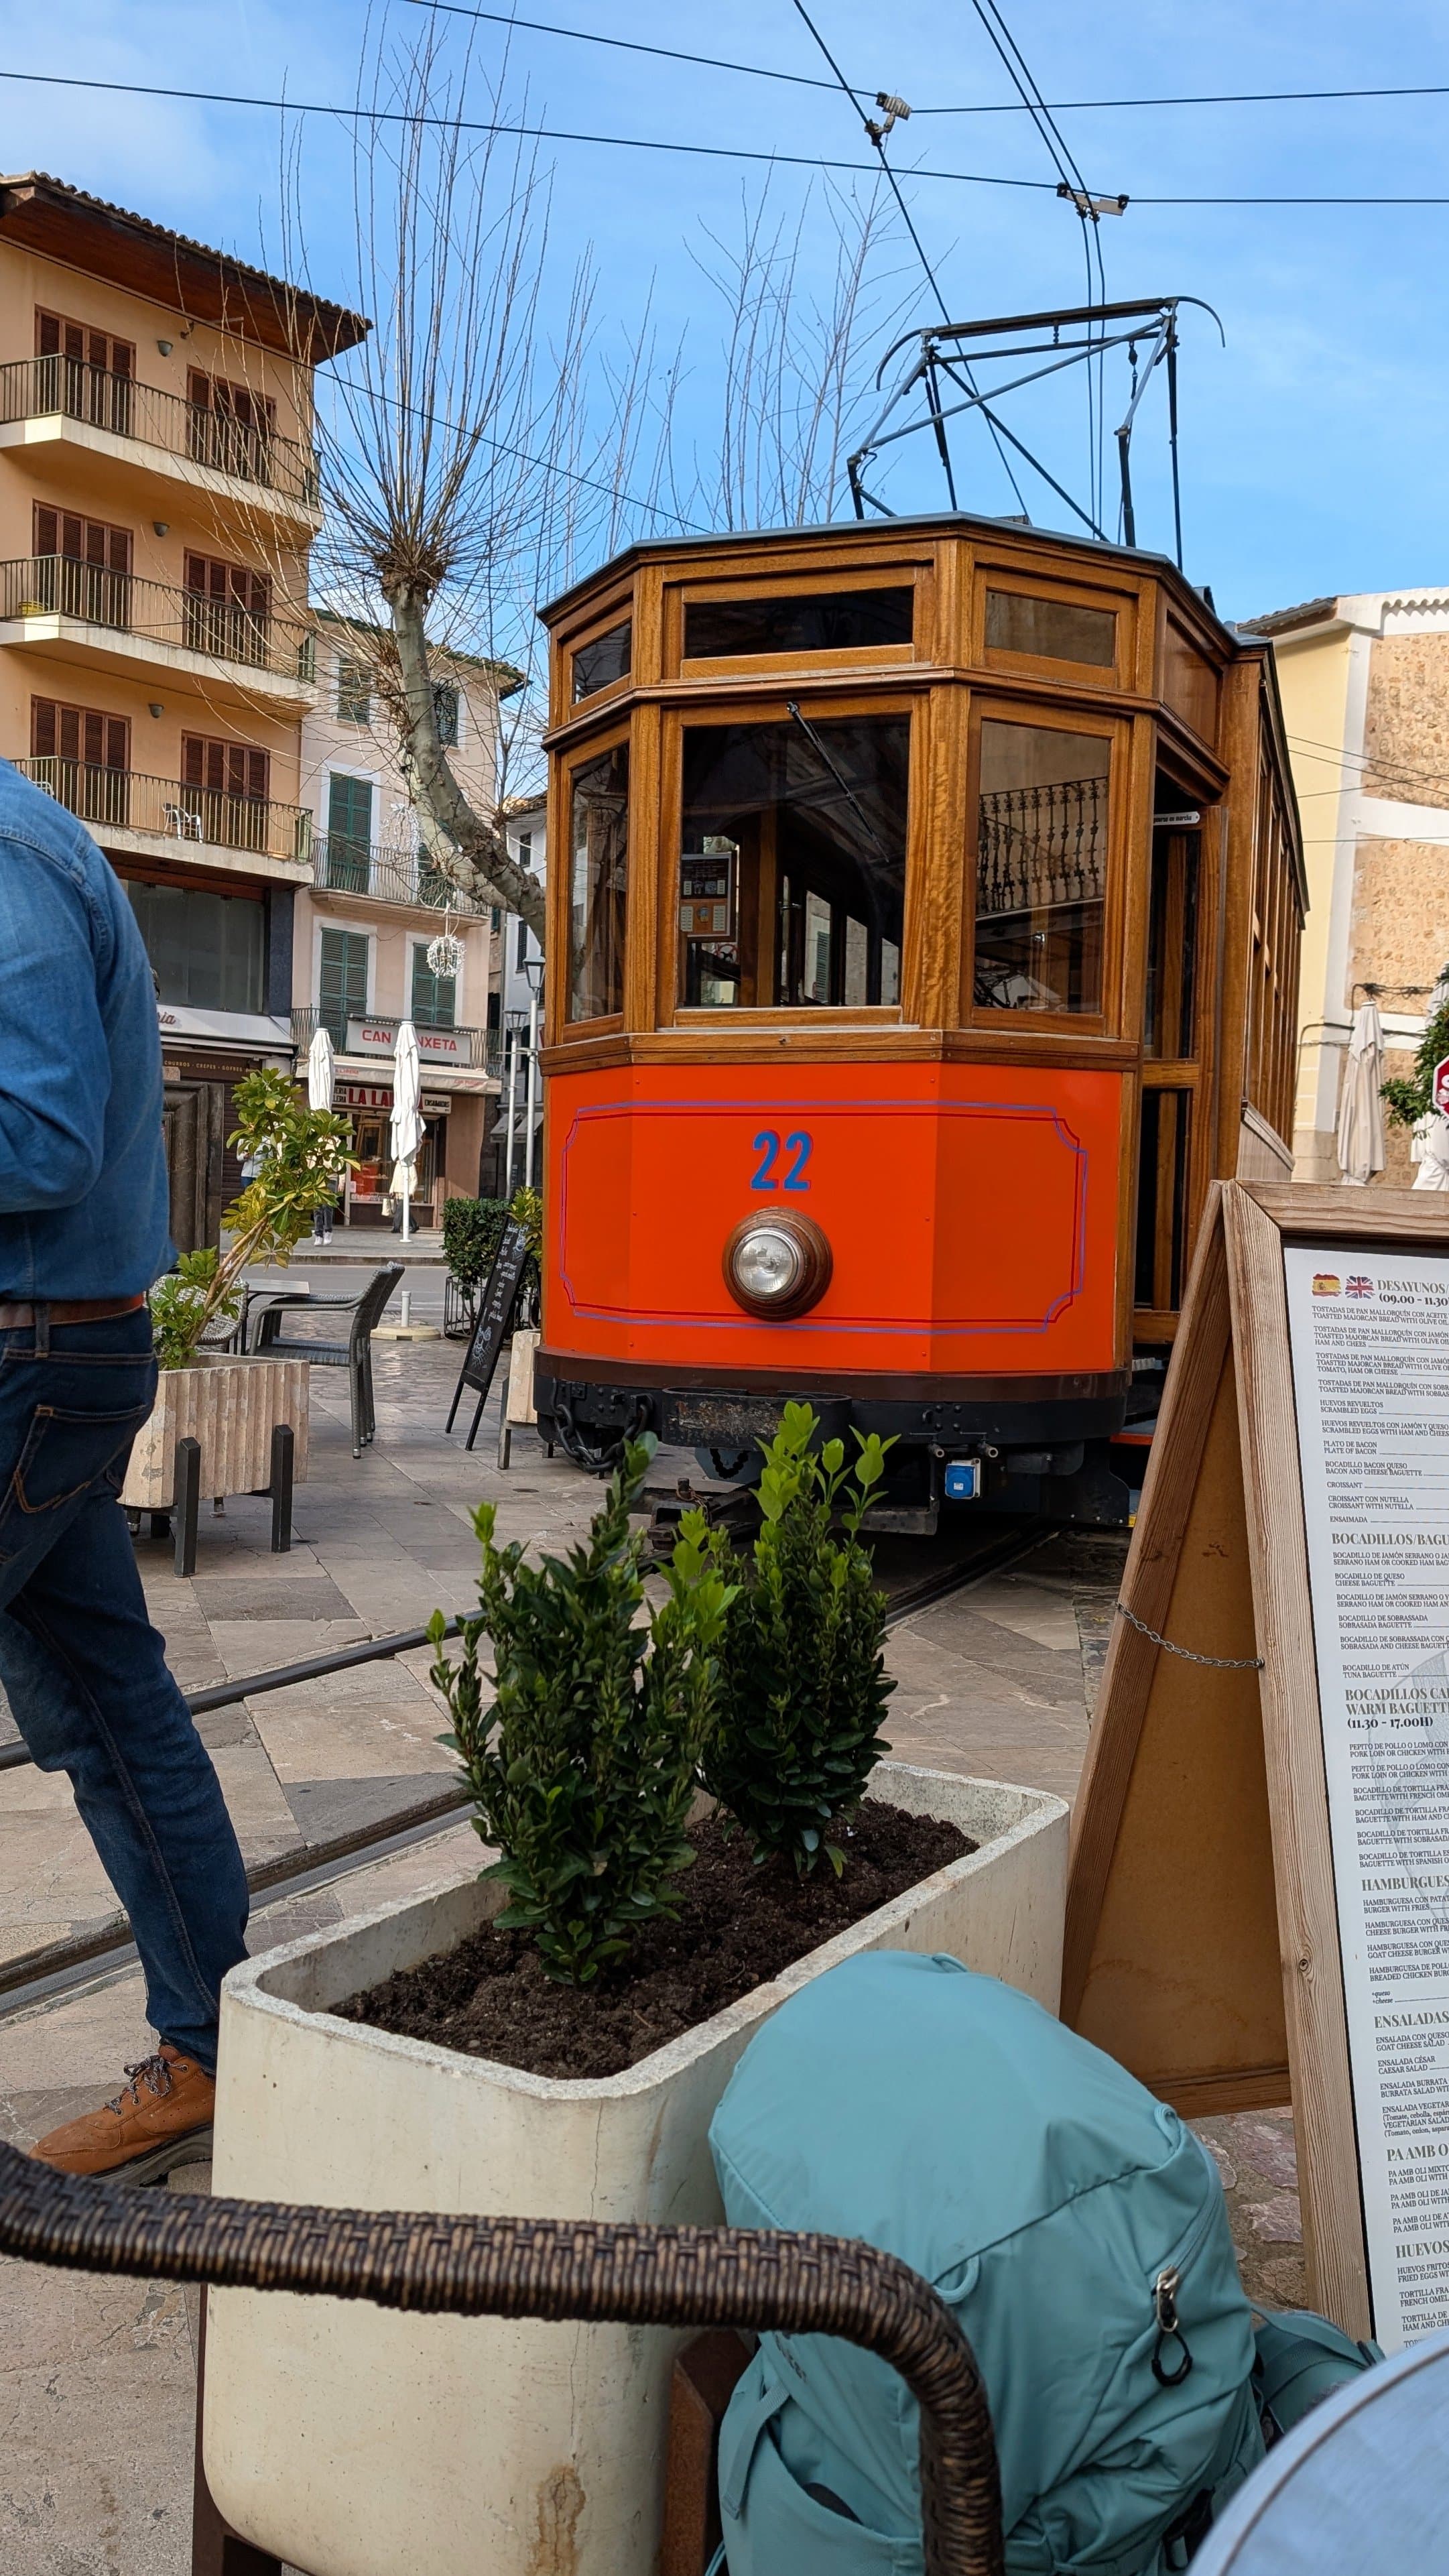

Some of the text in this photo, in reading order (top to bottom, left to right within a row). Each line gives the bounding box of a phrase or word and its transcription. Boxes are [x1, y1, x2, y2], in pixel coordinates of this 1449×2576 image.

[362, 1030, 391, 1043] CAN
[349, 1088, 367, 1105] LA
[750, 1129, 814, 1190] 22
[1379, 1292, 1414, 1305] (09.00
[1369, 1308, 1410, 1318] MALLORQUÍN
[1345, 1688, 1427, 1700] BOCADILLOS
[1346, 1703, 1385, 1715] WARM
[1347, 1717, 1378, 1729] (11.30
[1390, 1716, 1433, 1729] 17.00H)
[1363, 1897, 1413, 1906] HAMBURGUESA
[1369, 1971, 1432, 1981] BREADED CHICKEN
[1374, 2011, 1449, 2028] ENSALADAS
[1375, 2034, 1411, 2043] ENSALADA
[1396, 2041, 1422, 2049] CHEESE
[1377, 2054, 1435, 2067] ENSALADA CÉSAR
[1380, 2078, 1447, 2089] ENSALADA BURRATA
[1381, 2089, 1411, 2097] BURRATA
[1413, 2087, 1435, 2095] SALAD
[1382, 2103, 1418, 2113] ENSALADA
[1383, 2110, 1432, 2122] (Tomate, cebolla,
[1383, 2118, 1426, 2128] VEGETARIAN
[1384, 2128, 1411, 2138] (Tomato,
[1411, 2126, 1430, 2136] onion,
[1386, 2144, 1436, 2161] PA AMB
[1397, 2264, 1425, 2274] HUEVOS
[1397, 2272, 1438, 2282] FRIED EGGS
[1399, 2288, 1434, 2298] TORTILLA
[1400, 2297, 1428, 2307] FRENCH
[1401, 2312, 1436, 2323] TORTILLA
[1402, 2321, 1435, 2331] HAM AND
